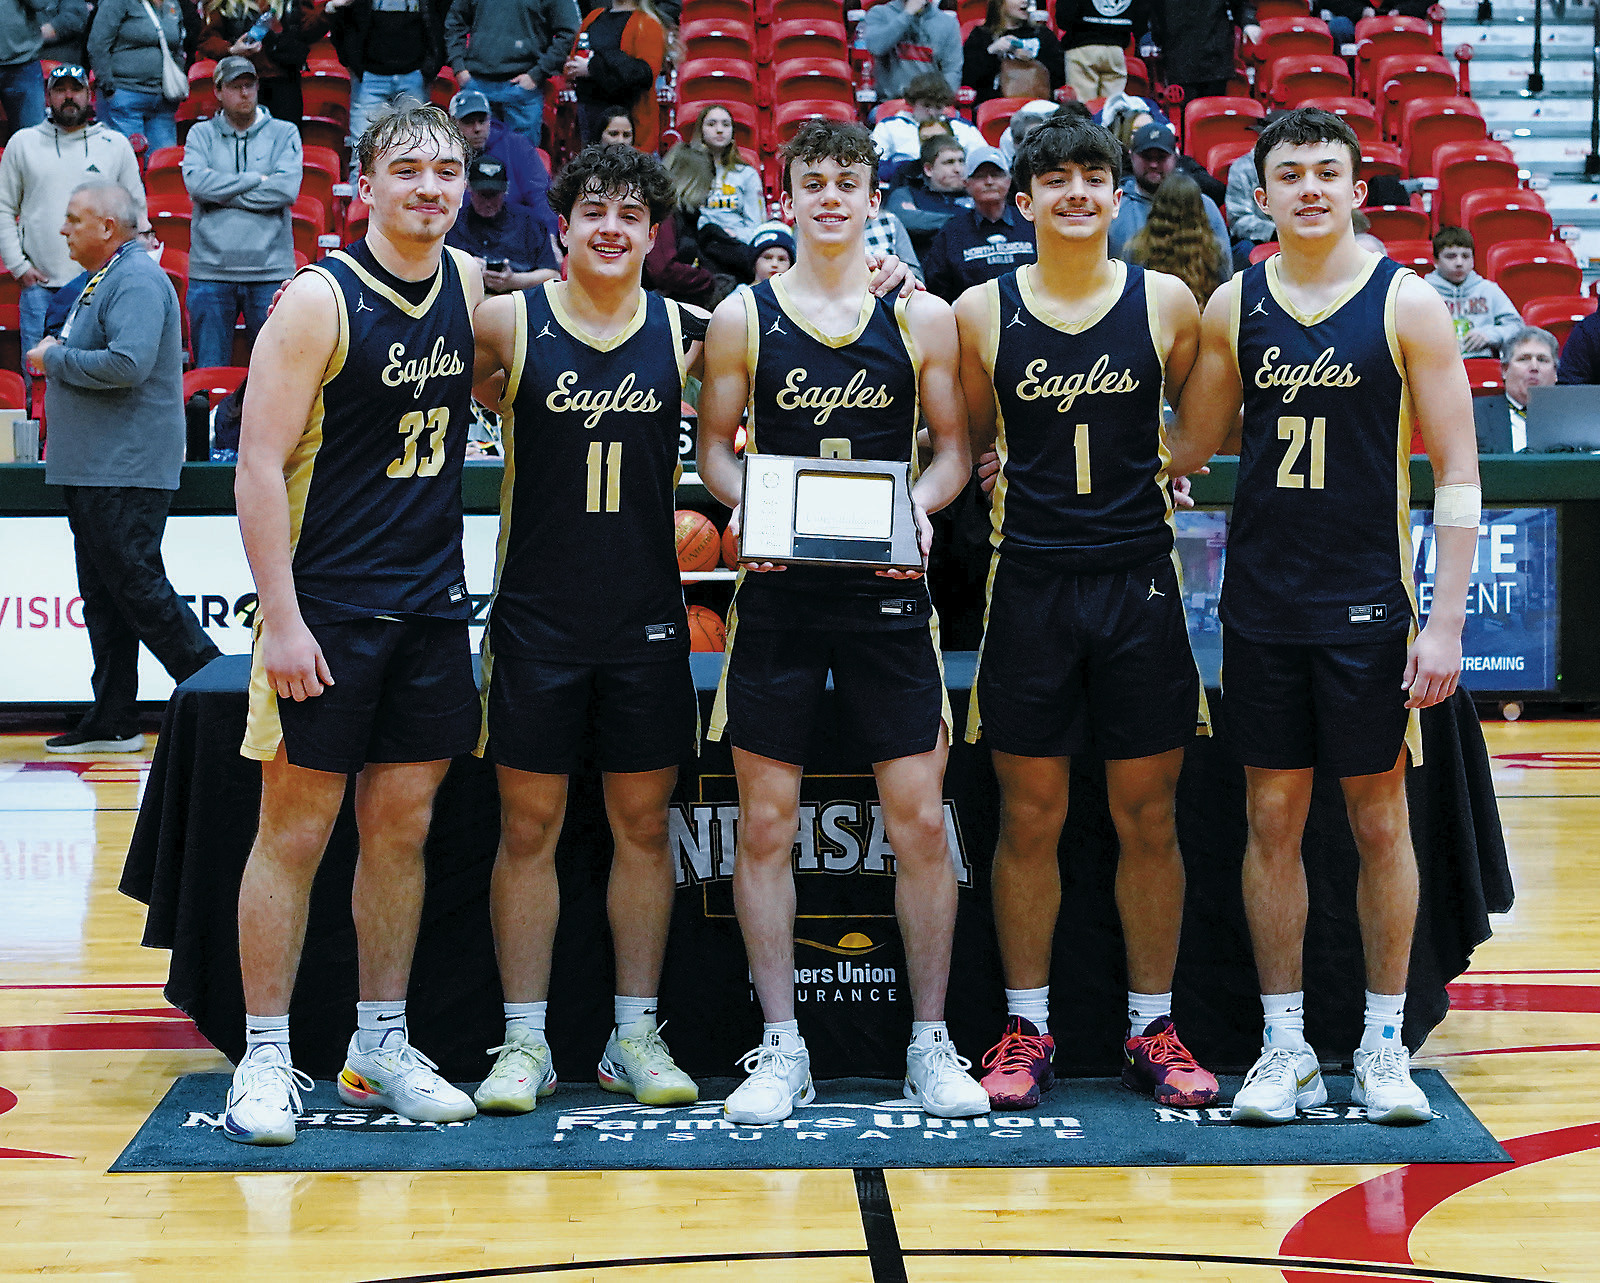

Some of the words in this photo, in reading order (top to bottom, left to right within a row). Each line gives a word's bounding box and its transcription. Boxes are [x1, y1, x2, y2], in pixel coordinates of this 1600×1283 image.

[382, 336, 464, 399] Eagles
[1016, 354, 1139, 412] Eagles
[1255, 346, 1360, 403] Eagles
[546, 371, 662, 428] Eagles
[777, 368, 893, 425] Eagles
[386, 407, 450, 478] 33
[1074, 424, 1091, 494] 1
[1277, 416, 1326, 489] 21
[586, 441, 622, 512] 11
[1460, 656, 1524, 671] TREAMING
[750, 988, 897, 1002] IURANCE
[836, 961, 896, 983] Union
[552, 1130, 1086, 1142] INSURANCE
[873, 1112, 1082, 1129] Union
